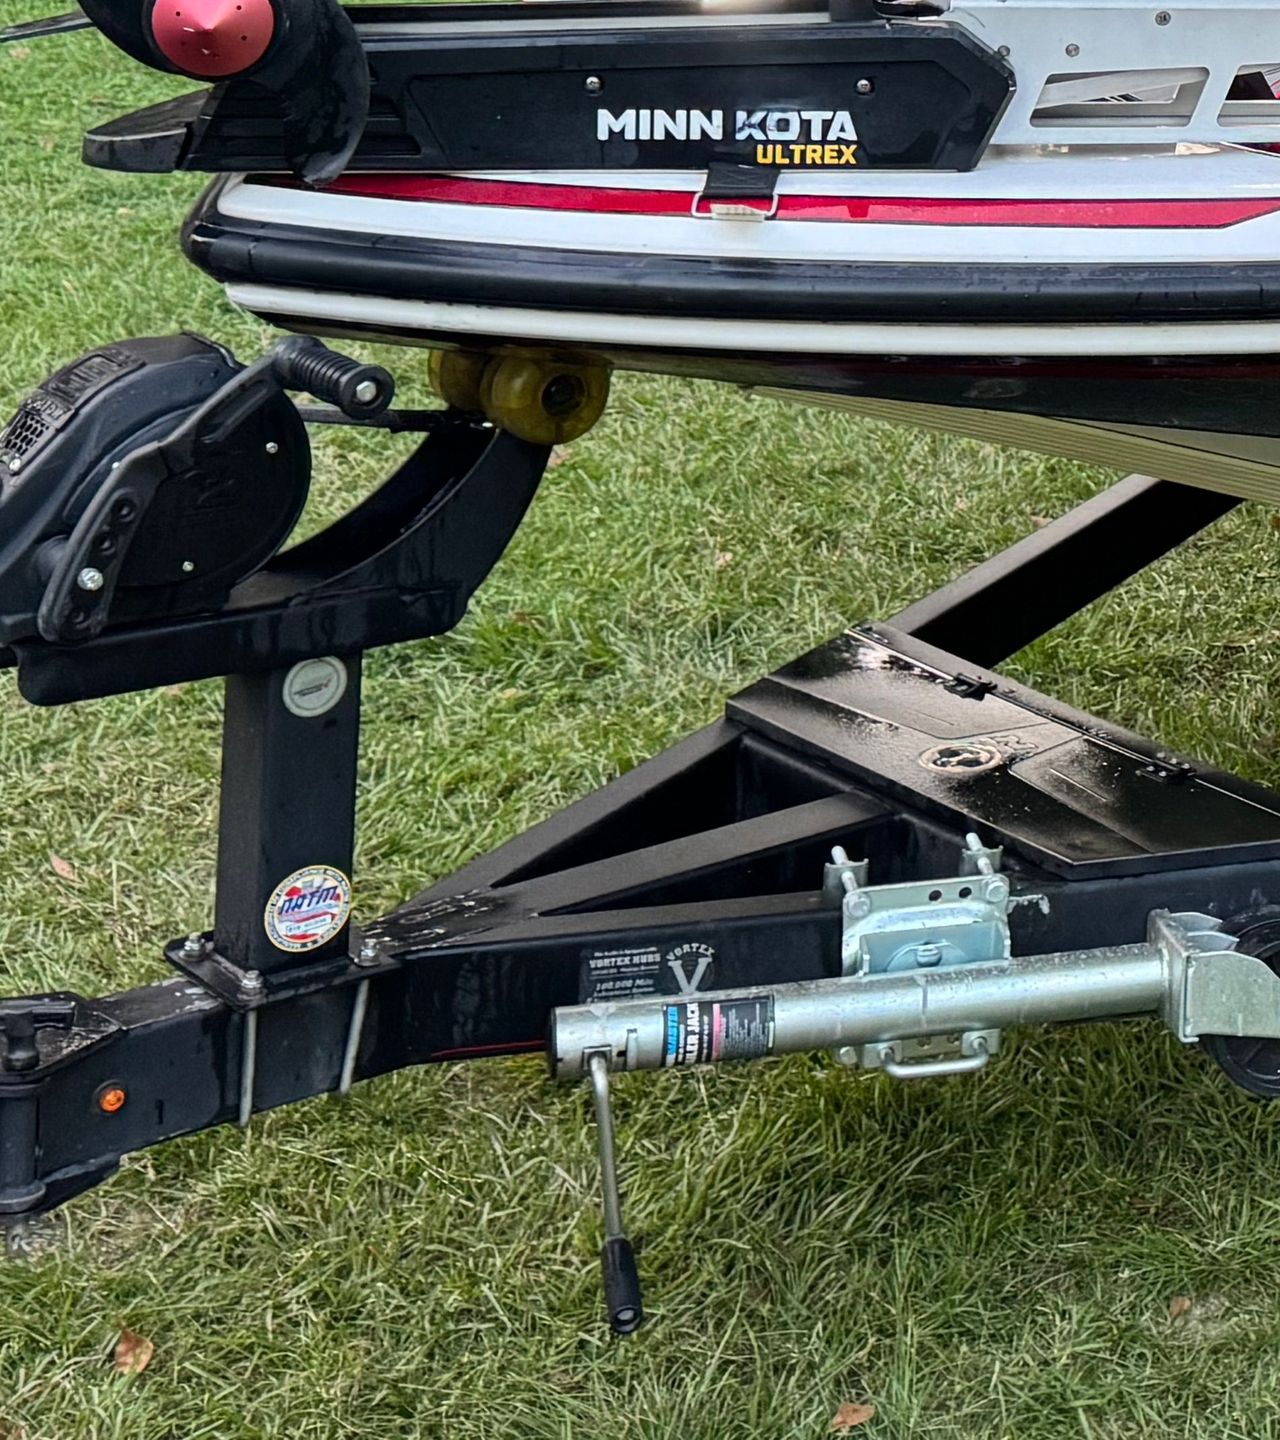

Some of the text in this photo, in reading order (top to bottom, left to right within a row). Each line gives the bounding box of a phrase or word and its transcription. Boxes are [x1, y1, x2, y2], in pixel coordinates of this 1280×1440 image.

[596, 108, 858, 142] MINN KOTA
[756, 144, 858, 165] ULTREX
[666, 942, 717, 960] VORTEX
